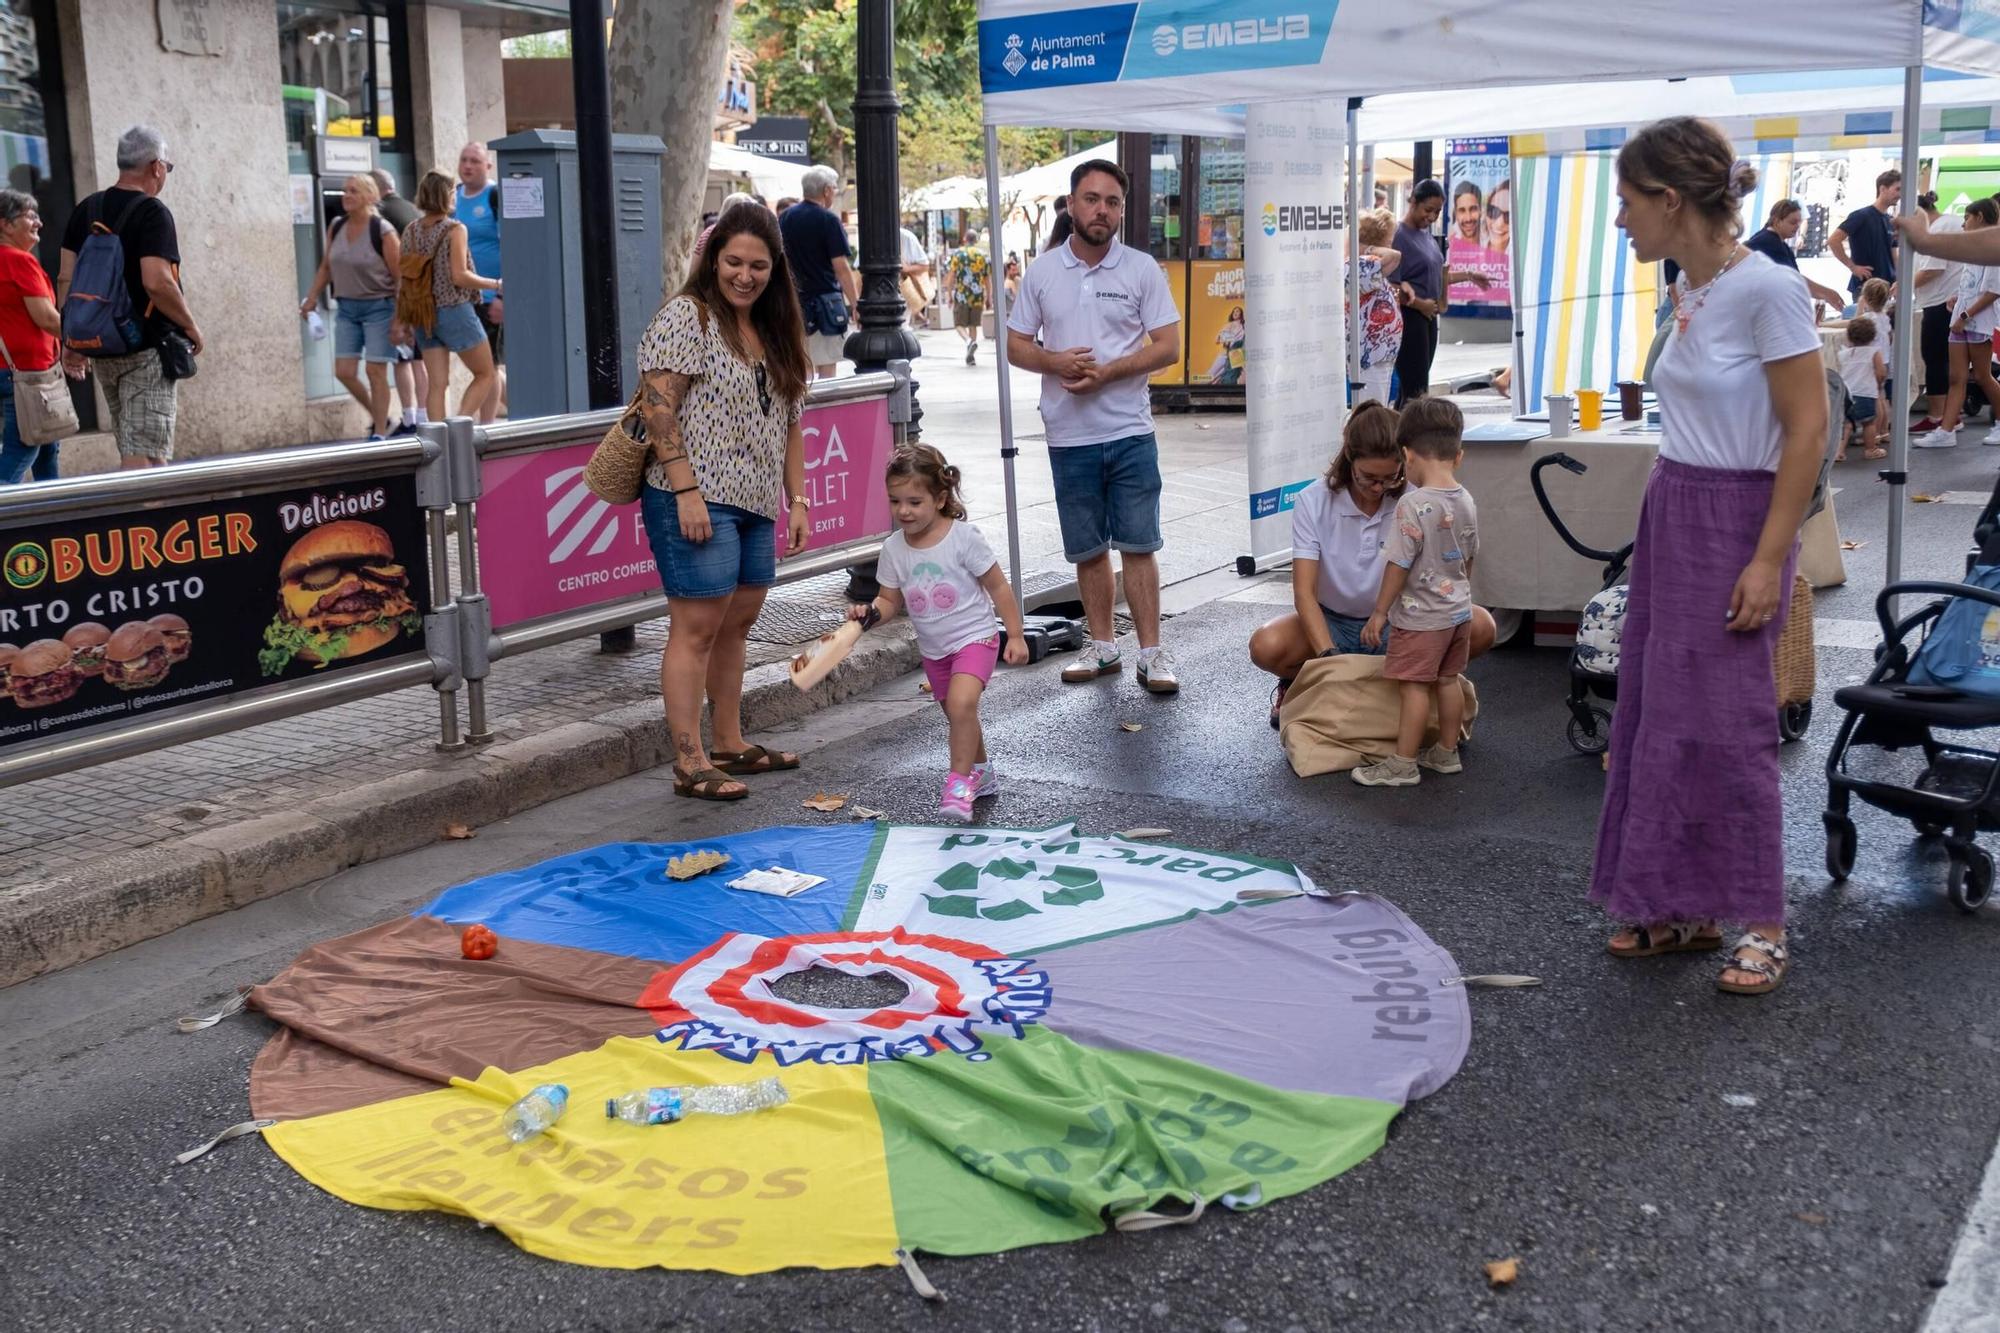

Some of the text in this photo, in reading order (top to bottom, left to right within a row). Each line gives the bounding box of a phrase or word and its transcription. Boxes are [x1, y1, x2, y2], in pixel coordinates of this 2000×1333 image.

[1032, 31, 1106, 54] Ajuntament
[1032, 52, 1096, 71] de Palma
[1454, 263, 1479, 272] YOUR
[279, 489, 385, 531] Delicious
[815, 515, 845, 533] EXIT 8
[86, 576, 205, 617] CRISTO
[558, 569, 610, 593] CENTRO
[38, 701, 127, 731] @cuevasdelshams
[132, 676, 234, 711] @dinosaurlandmallorca
[1098, 846, 1265, 884] parc
[1331, 928, 1432, 1043] rebuig
